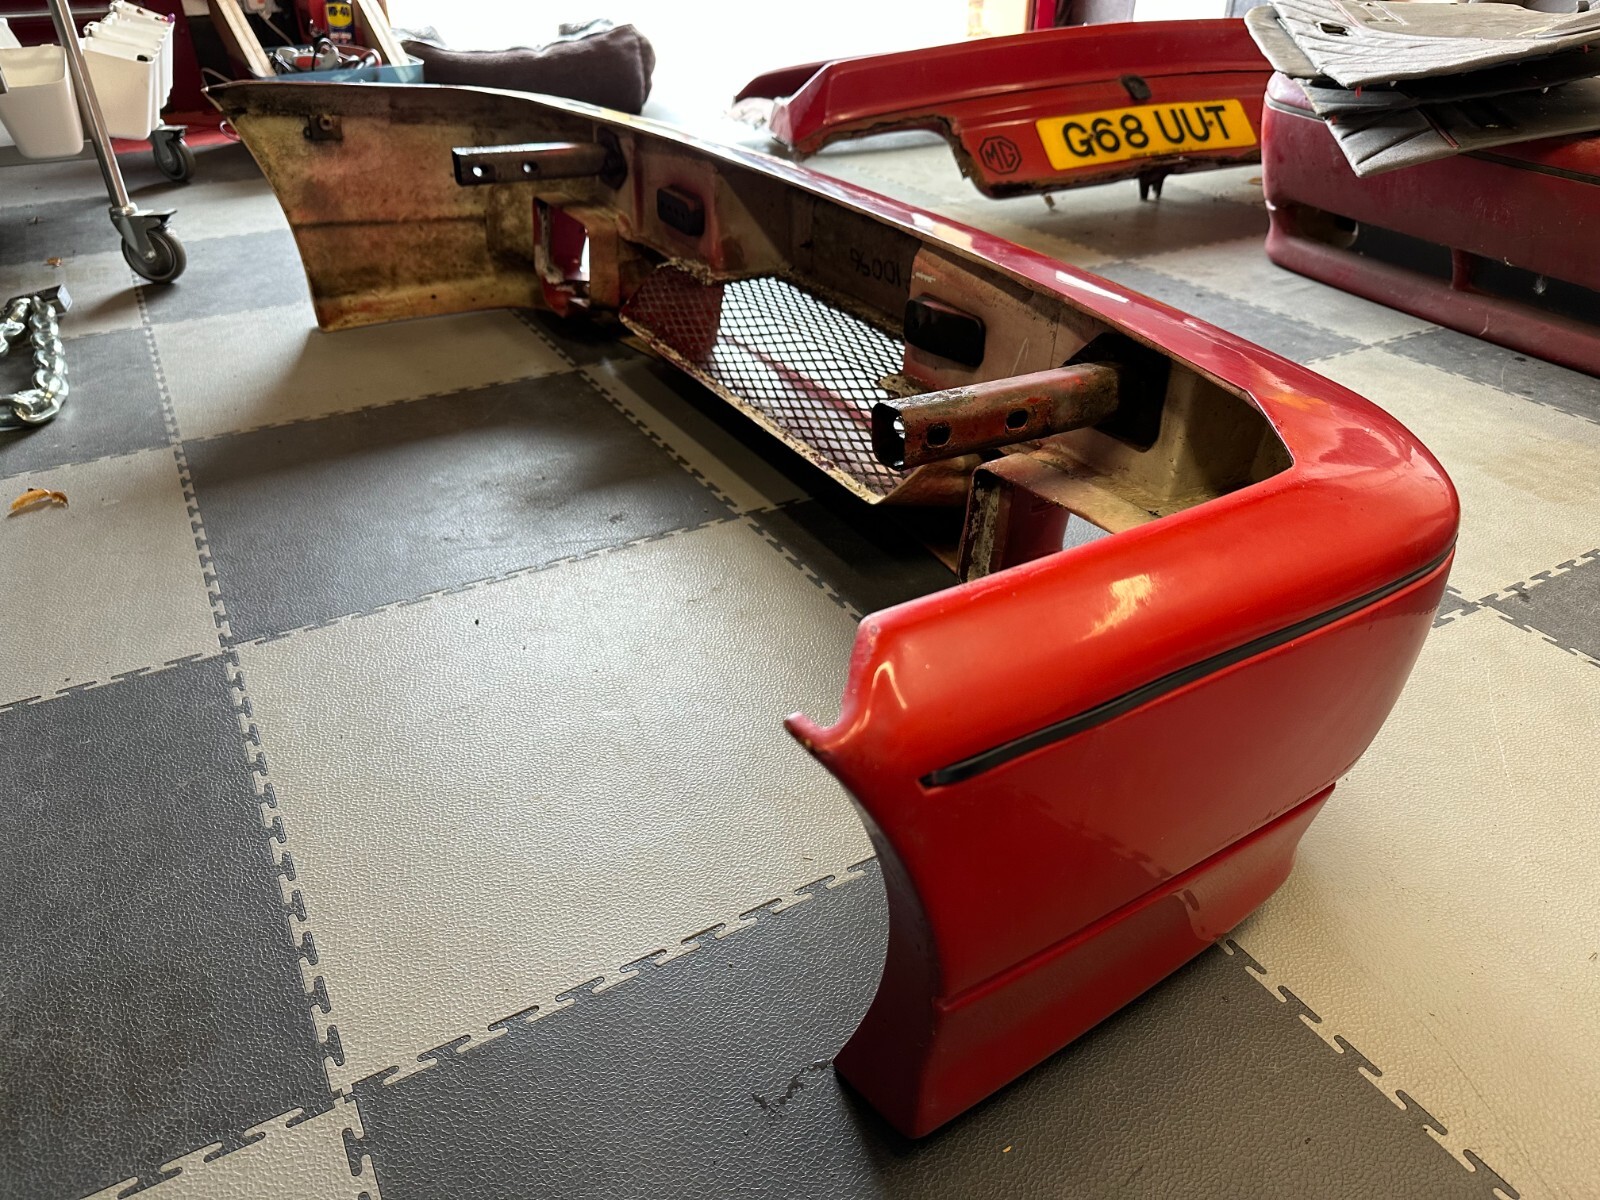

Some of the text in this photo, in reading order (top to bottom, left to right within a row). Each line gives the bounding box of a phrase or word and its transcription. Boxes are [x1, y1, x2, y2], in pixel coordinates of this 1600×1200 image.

[1062, 105, 1231, 158] G68 UUT
[984, 138, 1018, 172] MG
